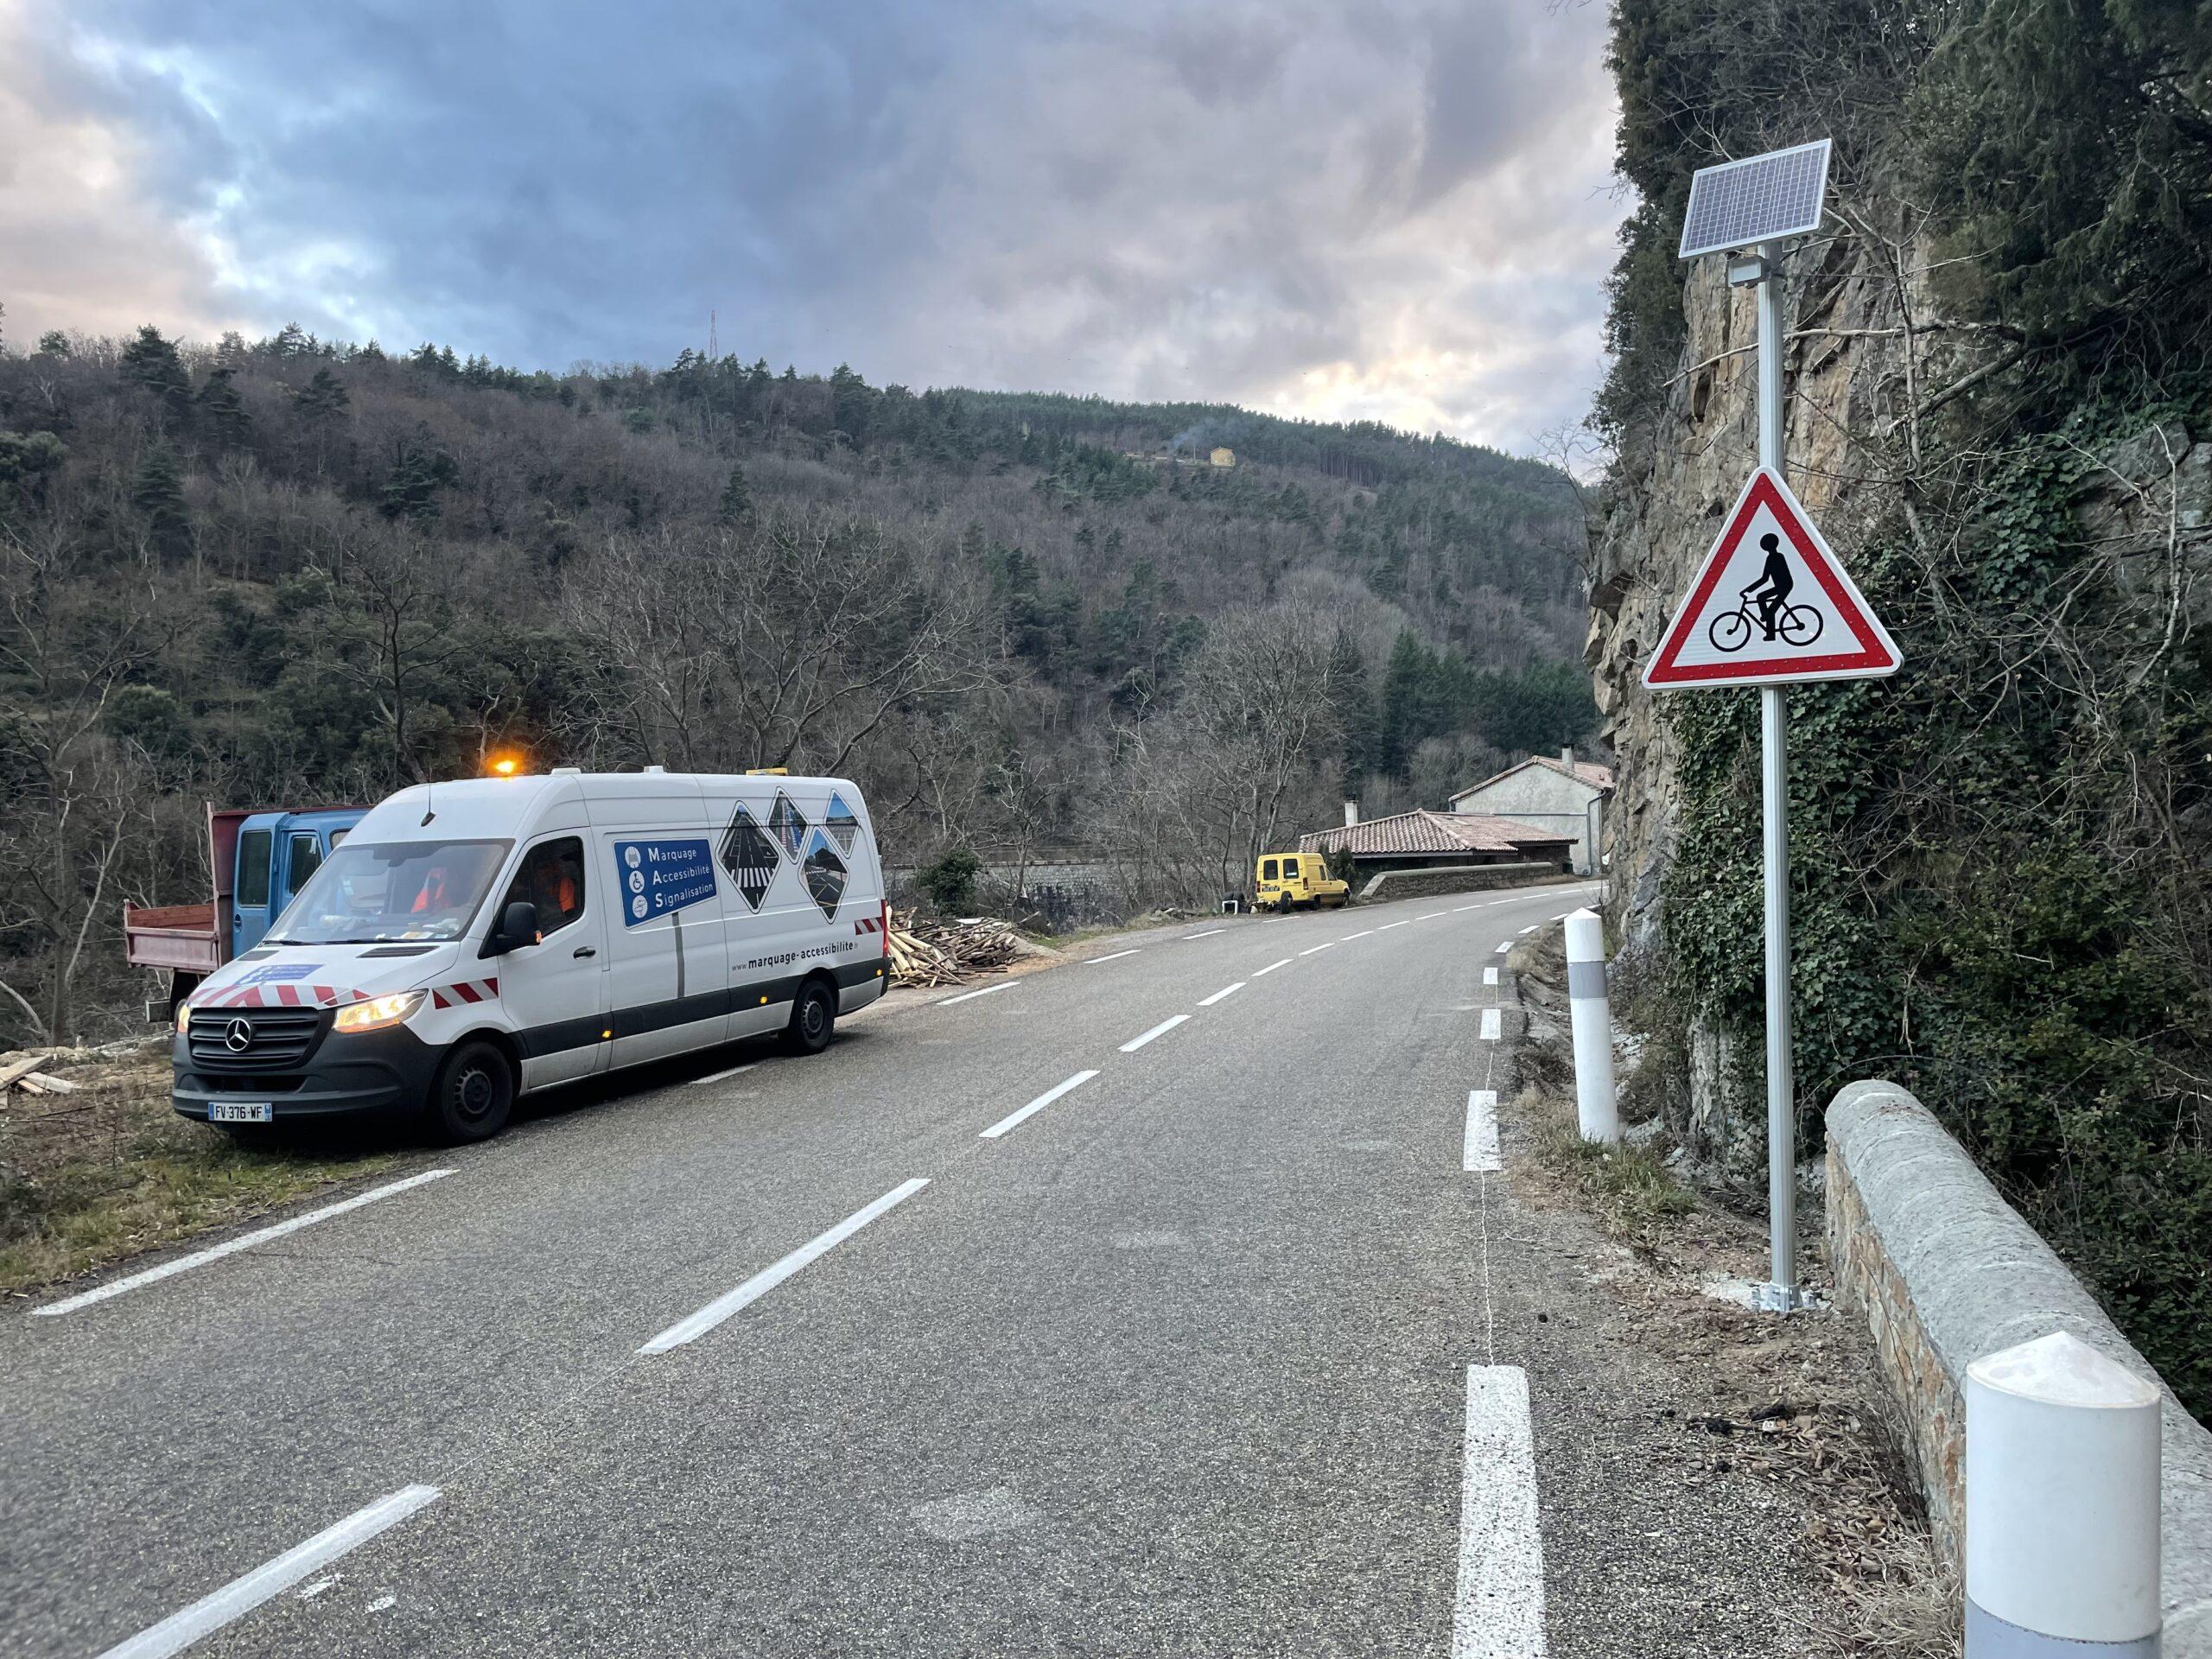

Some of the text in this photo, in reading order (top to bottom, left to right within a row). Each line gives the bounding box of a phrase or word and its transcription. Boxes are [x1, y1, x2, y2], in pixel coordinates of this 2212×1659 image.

[648, 848, 696, 861] Marquage
[652, 864, 710, 886] Accessibilité
[655, 883, 714, 907] Signalisation
[732, 940, 858, 971] wwwmarquage-accessibilite
